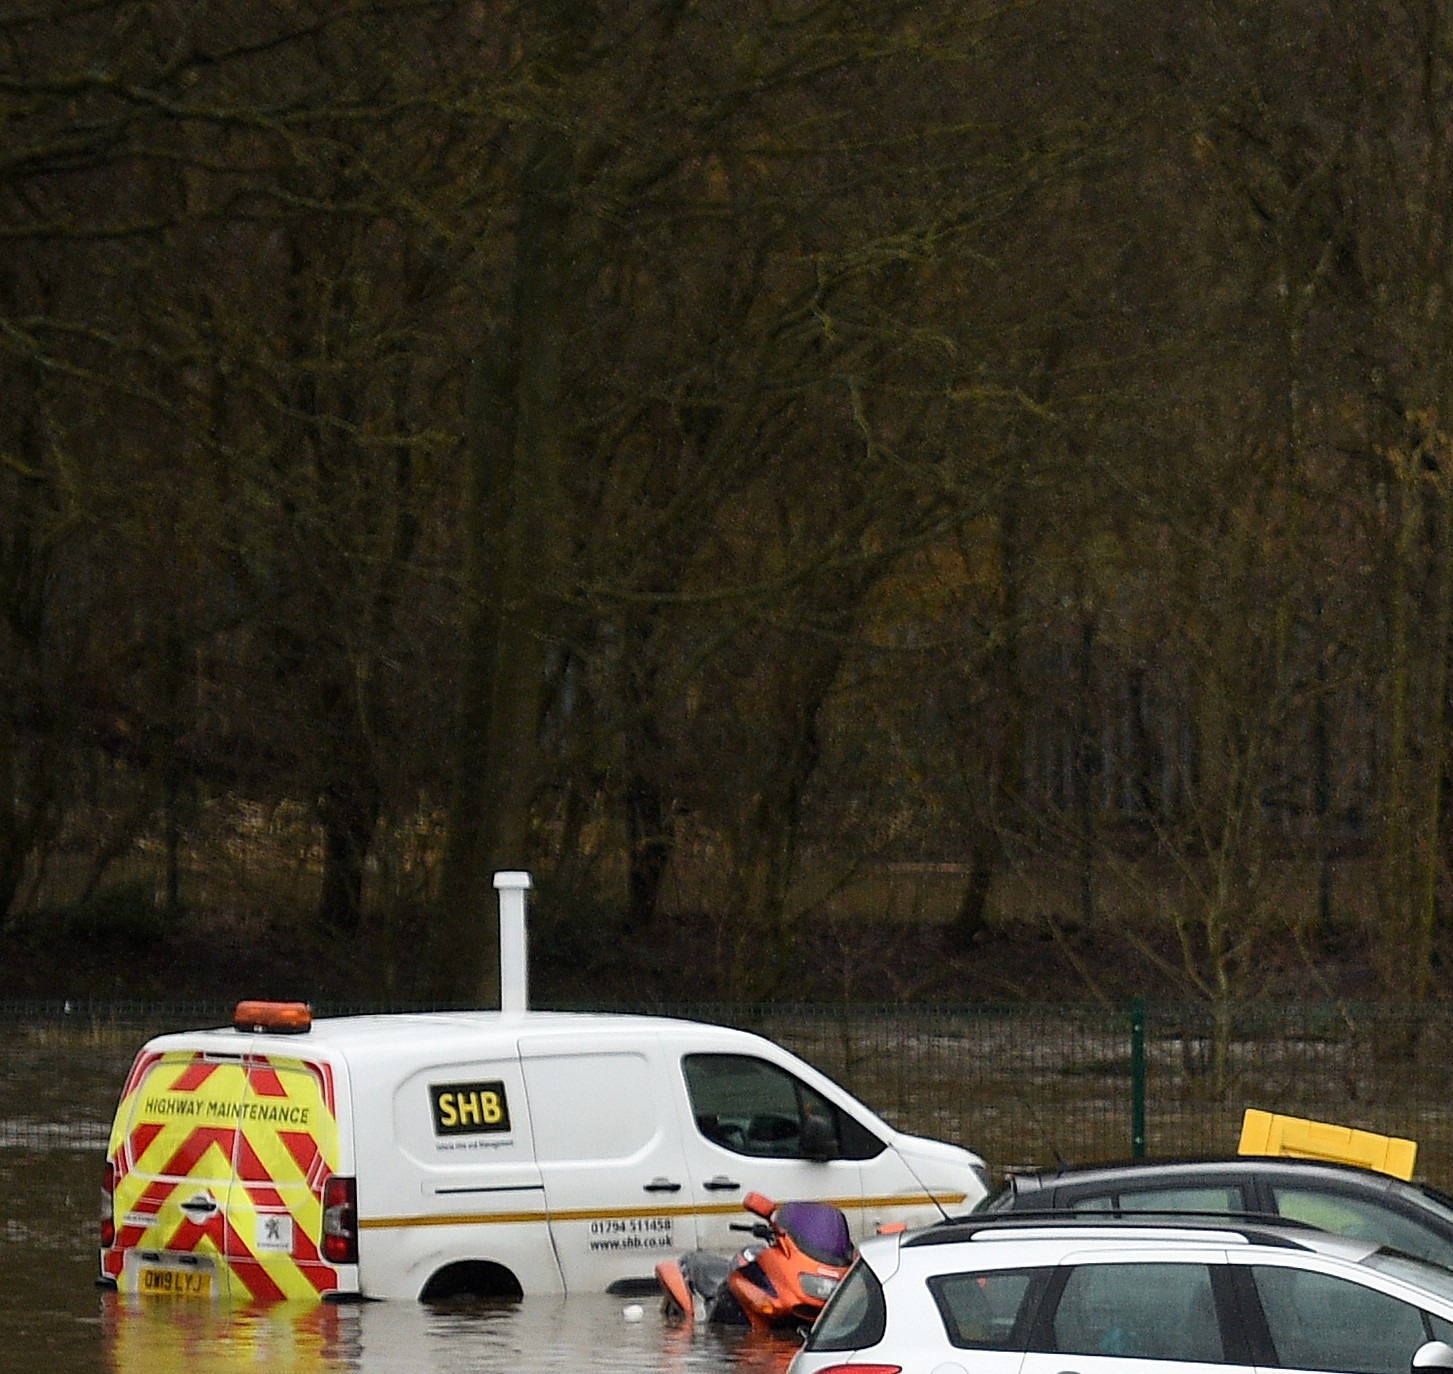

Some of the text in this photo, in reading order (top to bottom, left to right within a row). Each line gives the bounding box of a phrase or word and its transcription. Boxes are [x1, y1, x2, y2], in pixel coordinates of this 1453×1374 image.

[145, 1098, 309, 1124] HIGHWAY MAINTENANCE
[438, 1091, 502, 1127] SHB
[591, 1221, 626, 1234] 01794
[590, 1235, 672, 1251] www.shb.co.uk
